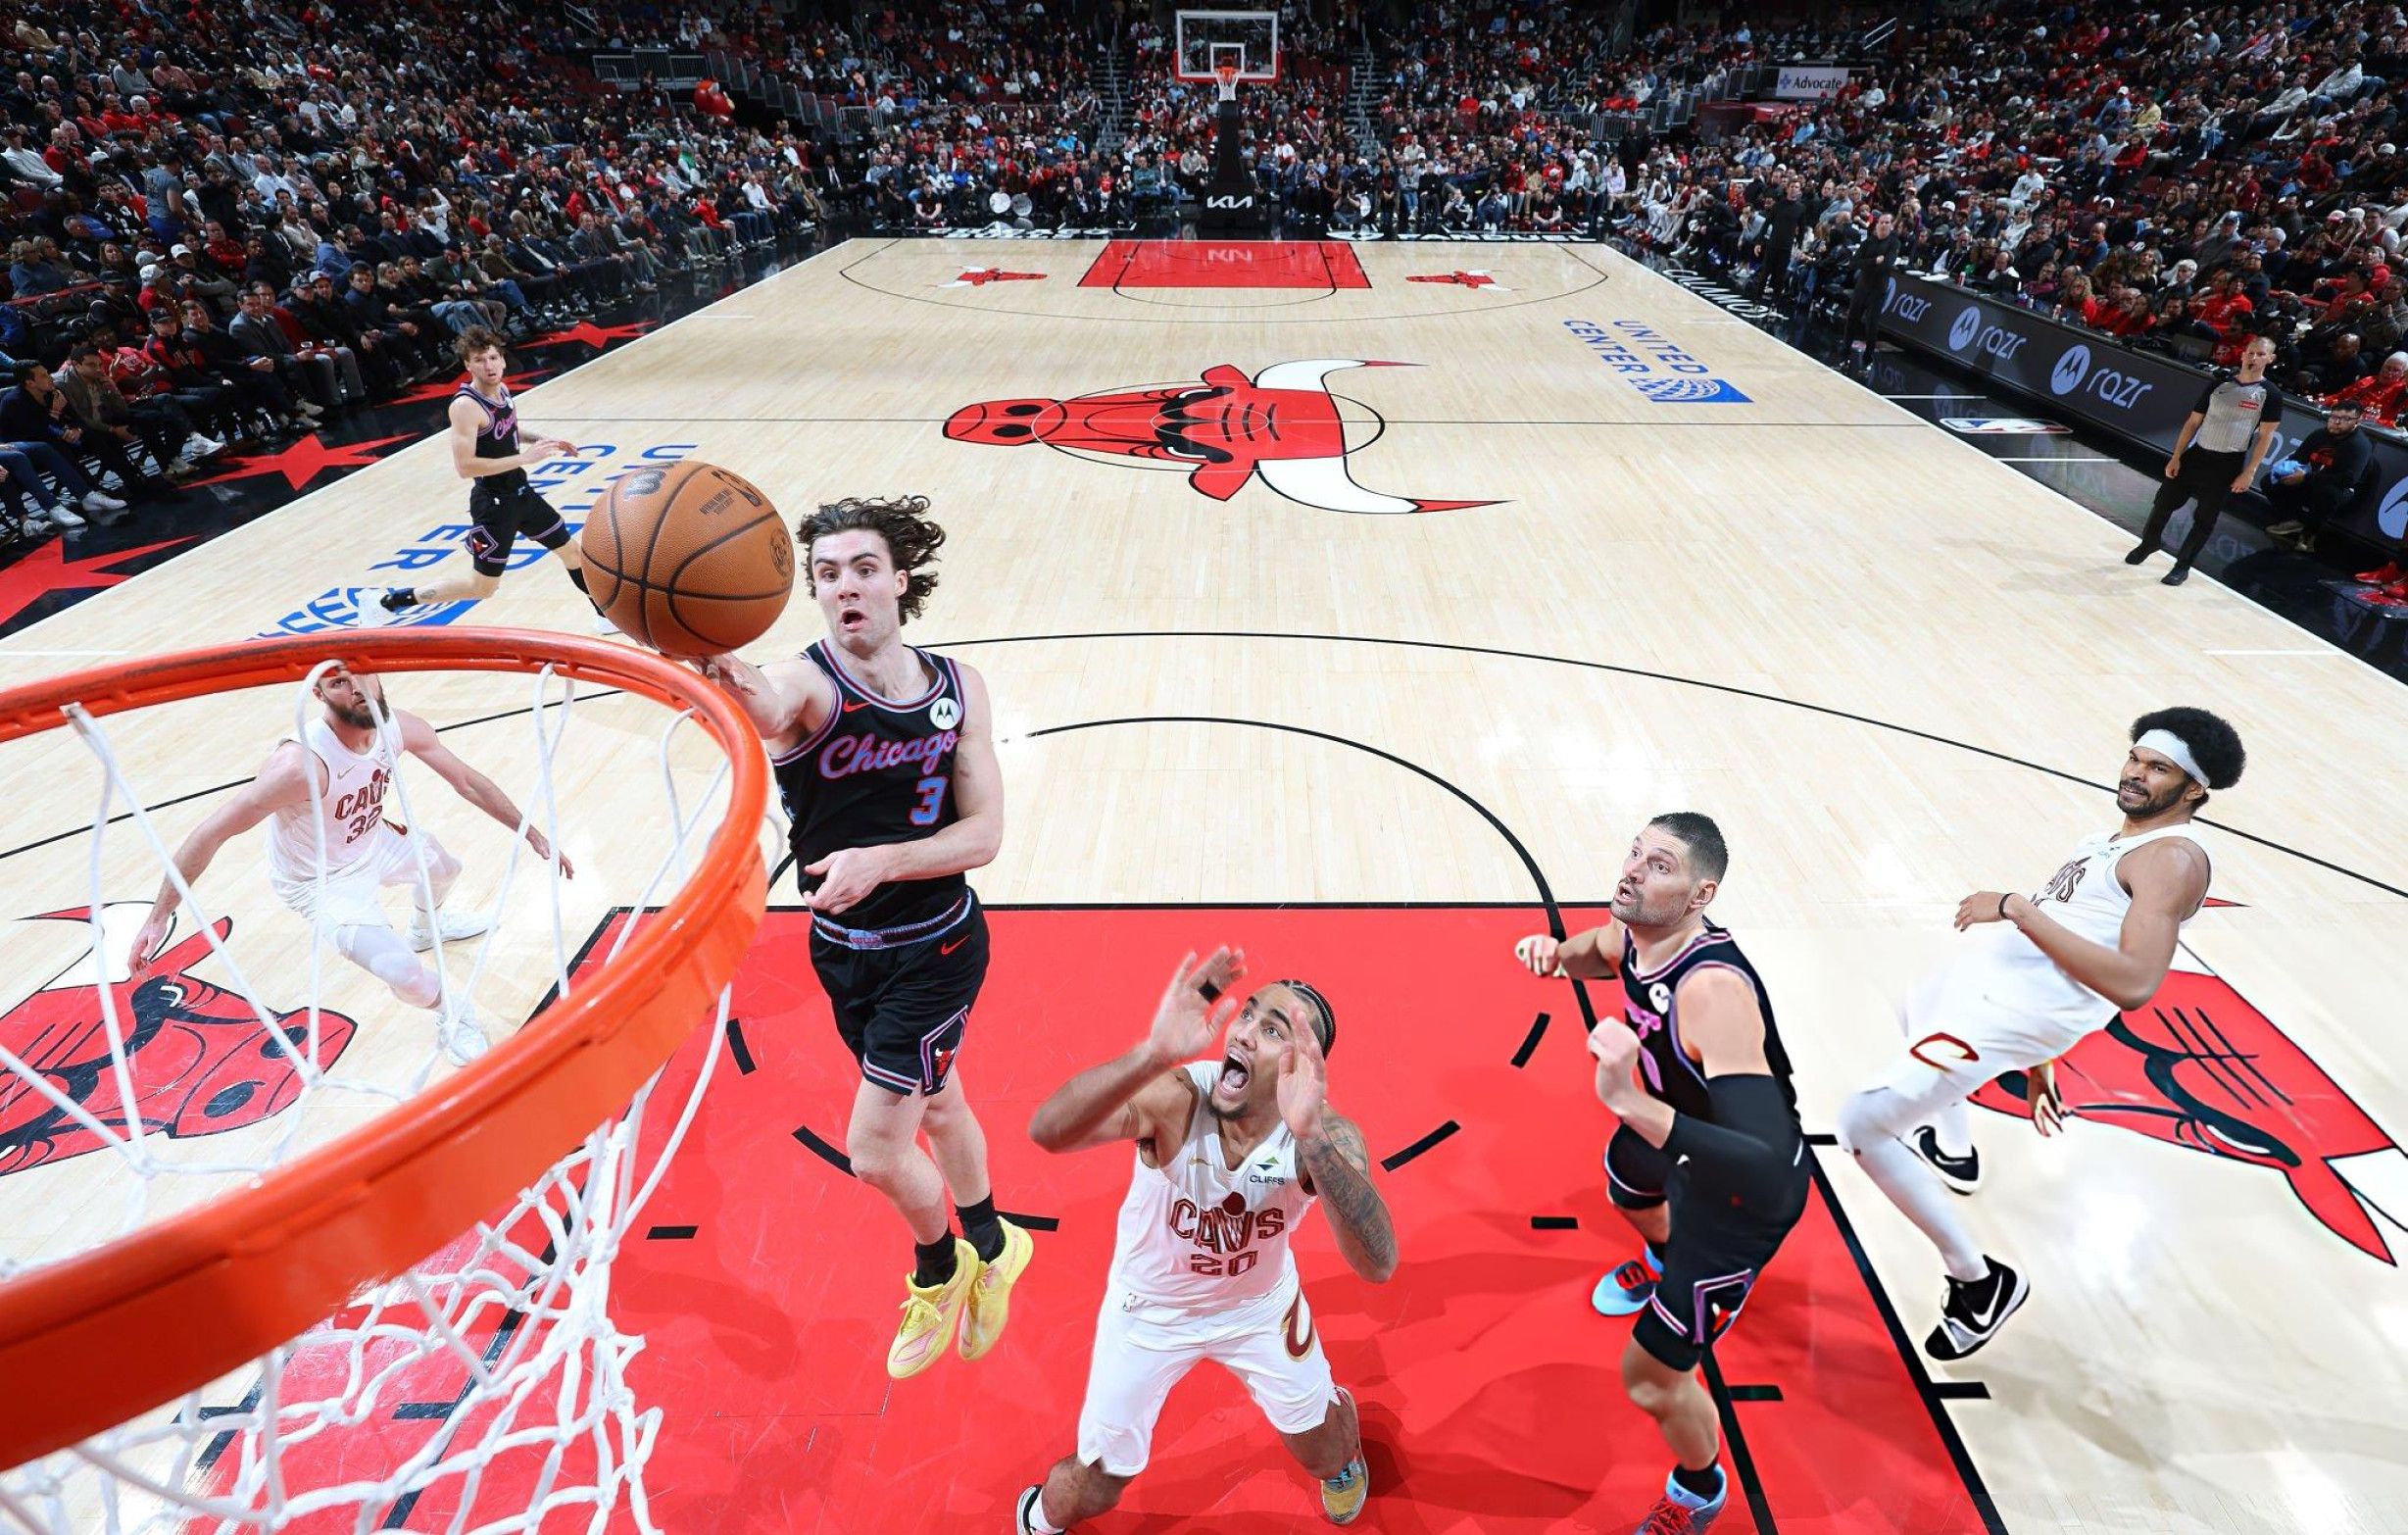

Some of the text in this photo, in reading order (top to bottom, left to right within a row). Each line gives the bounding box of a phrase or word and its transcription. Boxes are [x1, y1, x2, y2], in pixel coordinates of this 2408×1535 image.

[1793, 75, 1843, 89] Advocate
[1206, 194, 1253, 209] KIA
[1892, 293, 1932, 322] razr
[1562, 320, 1651, 373] CENTER
[1612, 320, 1709, 374] UNITED
[1977, 325, 2026, 360] razr
[2087, 369, 2152, 409] razr
[818, 729, 960, 779] Chicago
[906, 775, 950, 826] 3
[346, 806, 383, 844] 32
[1170, 1198, 1285, 1255] CAVS
[1190, 1250, 1258, 1277] 20
